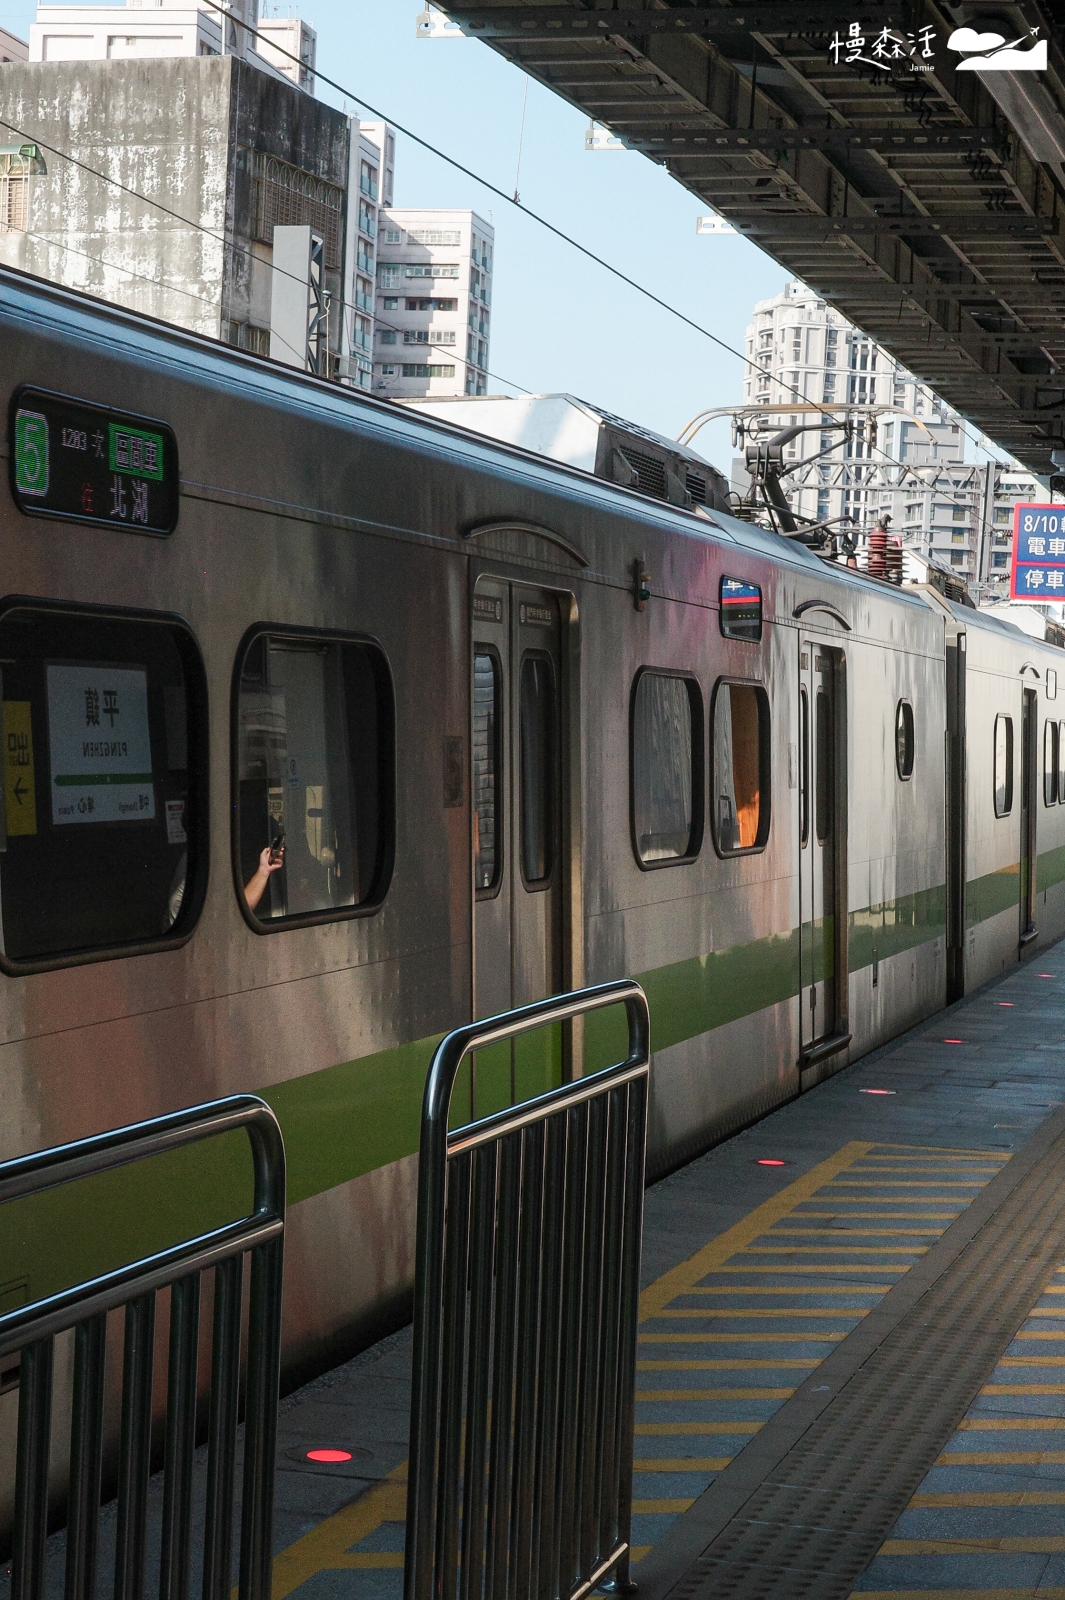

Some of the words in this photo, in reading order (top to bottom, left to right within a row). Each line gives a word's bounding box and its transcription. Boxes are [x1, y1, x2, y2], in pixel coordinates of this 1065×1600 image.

[24, 423, 41, 483] 5
[116, 432, 158, 474] 區間車
[110, 475, 148, 523] 北湖
[1023, 514, 1065, 533] 8/10
[1027, 536, 1065, 557] 電車
[1025, 569, 1065, 590] 停車
